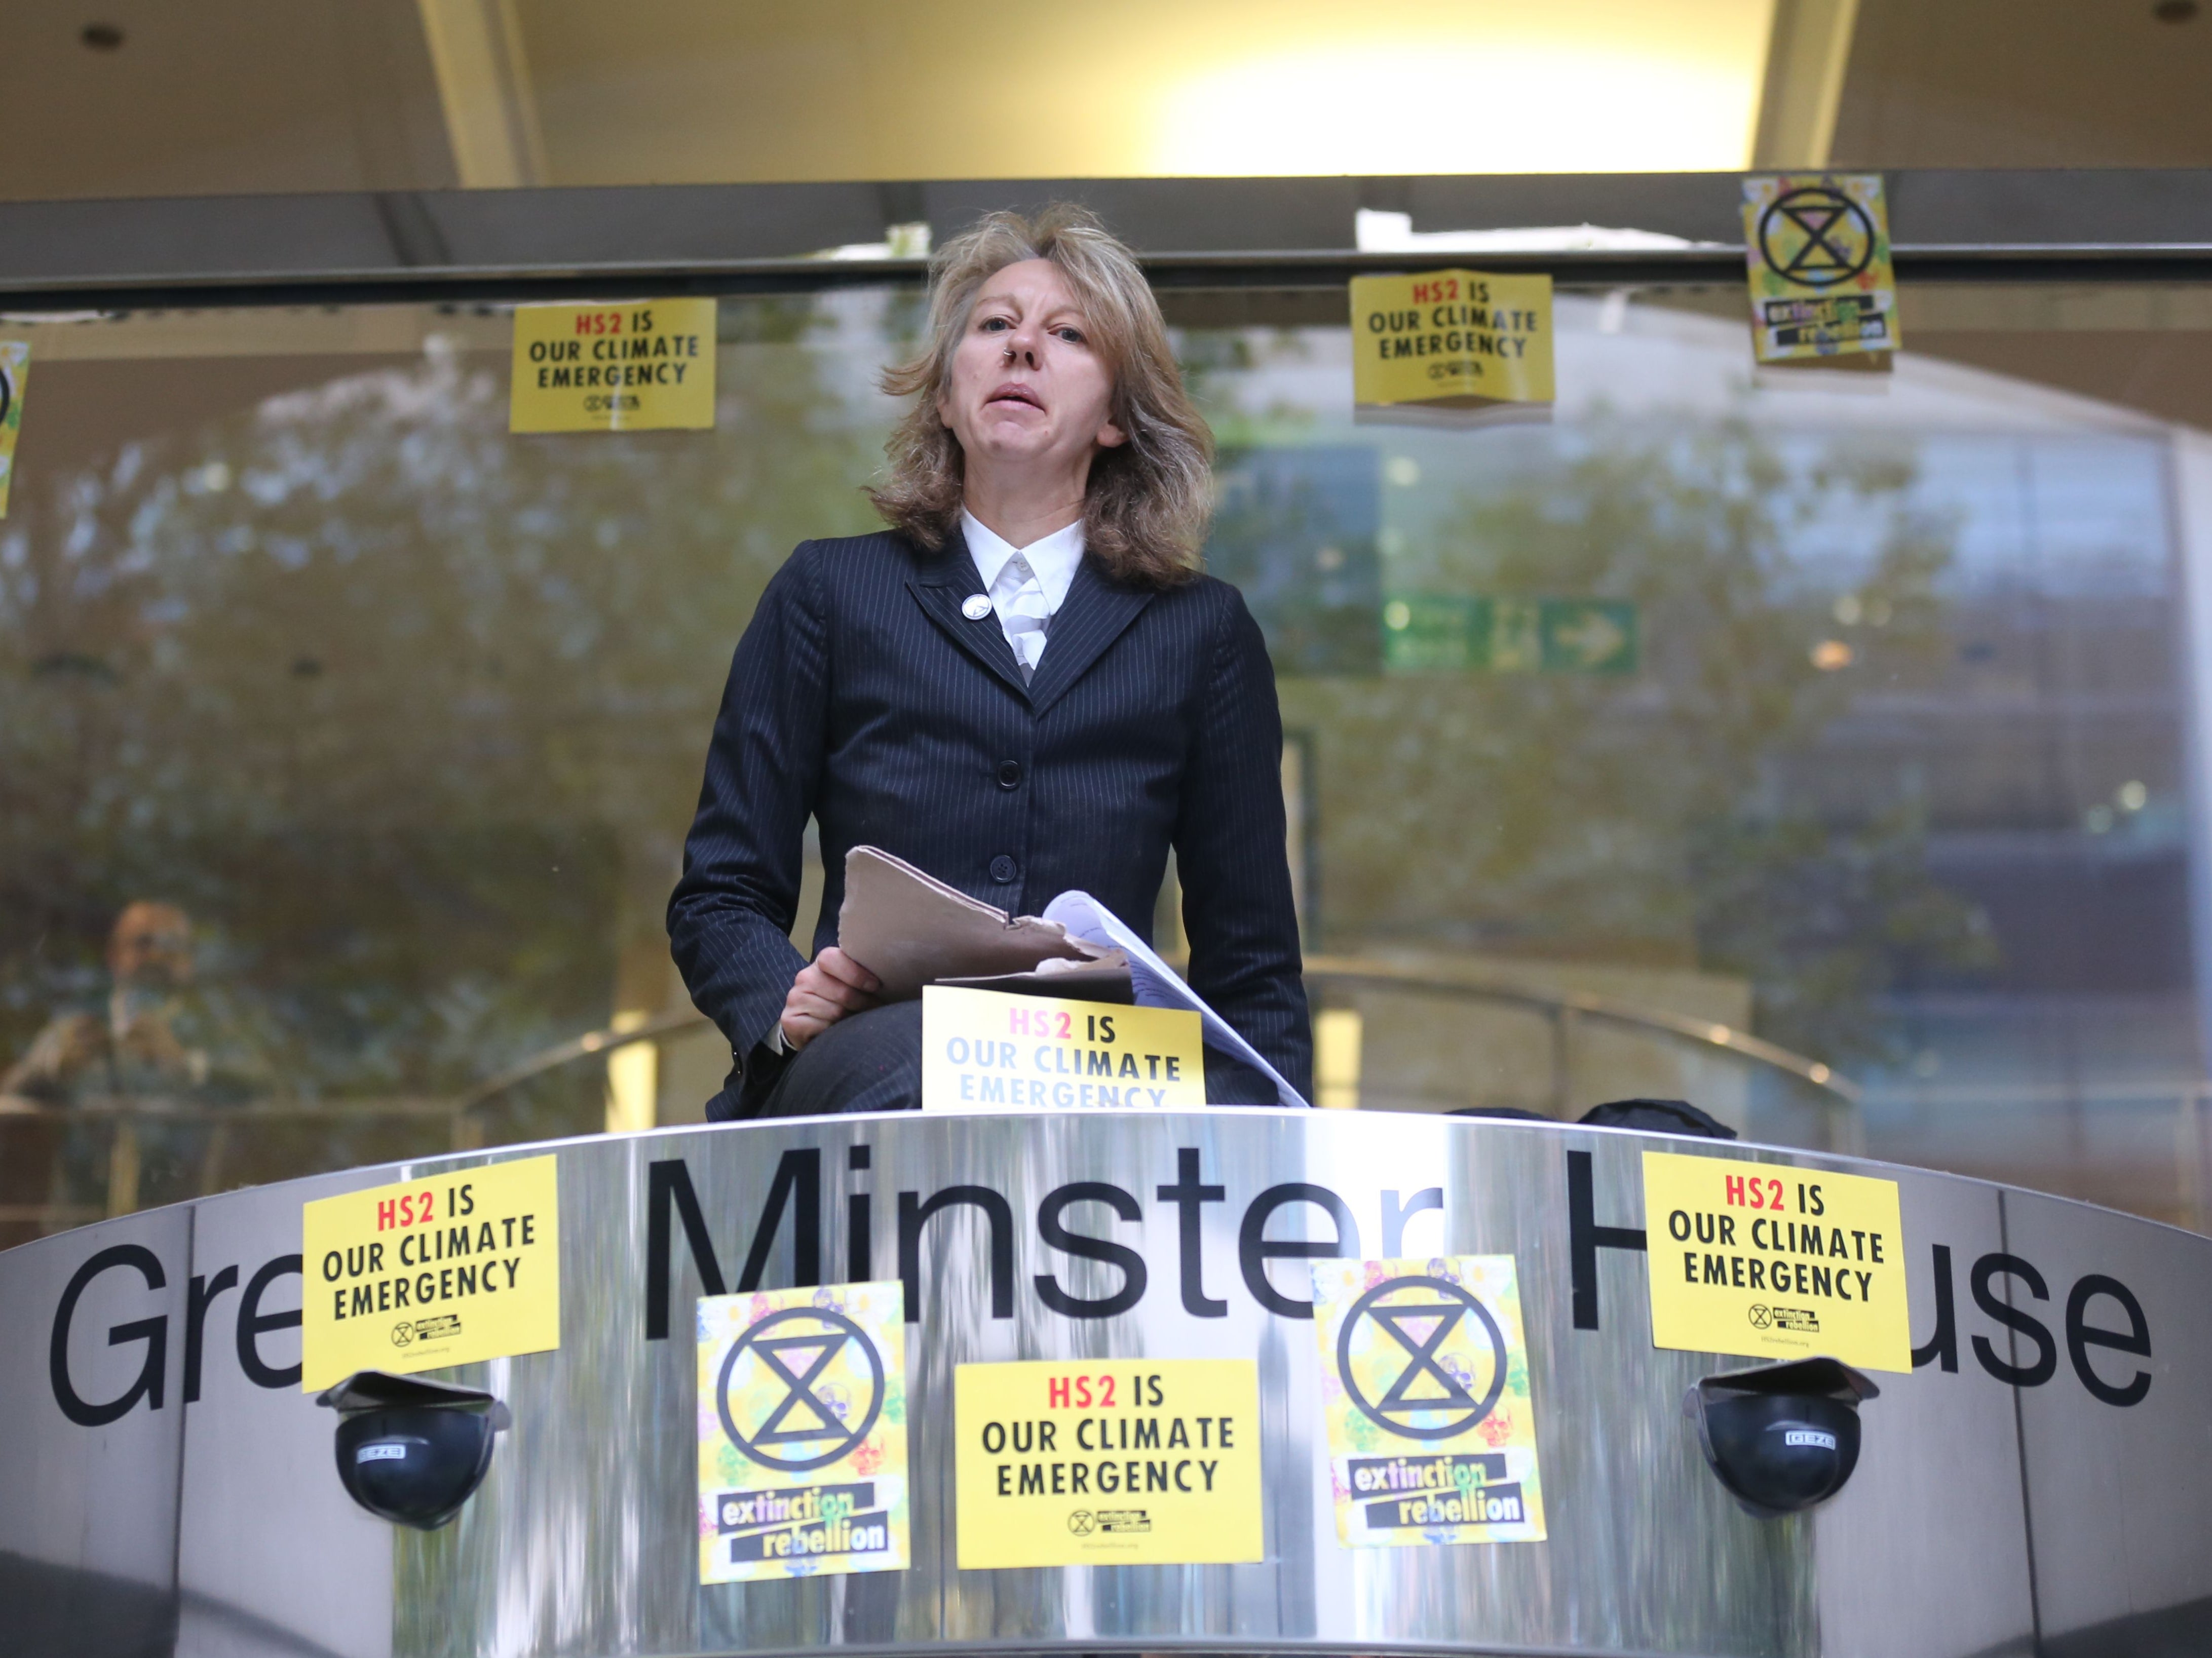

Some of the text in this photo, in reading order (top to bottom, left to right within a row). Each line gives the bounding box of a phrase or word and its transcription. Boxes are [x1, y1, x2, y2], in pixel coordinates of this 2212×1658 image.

[1413, 279, 1490, 304] HS2 IS
[576, 310, 653, 335] HS2 IS
[1369, 306, 1537, 333] OUR CLIMATE
[529, 335, 699, 362] OUR CLIMATE
[1379, 331, 1527, 359] EMERGENCY
[538, 363, 687, 388] EMERGENCY
[1010, 1008, 1116, 1044] HS2 IS
[946, 1036, 1180, 1082] OUR CLIMATE
[960, 1073, 1166, 1108] EMERGENCY
[377, 1184, 474, 1231] HS2 IS
[1726, 1175, 1825, 1216] HS2 IS
[323, 1214, 535, 1282] OUR CLIMATE
[646, 1145, 1443, 1339] Minster
[1669, 1210, 1884, 1264] OUR CLIMATE
[334, 1257, 521, 1321] EMERGENCY
[1684, 1252, 1873, 1302] EMERGENCY
[1774, 1308, 1810, 1321] extinction
[1786, 1319, 1819, 1332] rebellion
[1049, 1375, 1164, 1409] HS2 IS
[982, 1417, 1234, 1453] OUR CLIMATE
[1788, 1433, 1834, 1448] GEZE
[998, 1459, 1218, 1496] EMERGENCY
[1354, 1456, 1488, 1491] extinction
[722, 1487, 855, 1526] extinction
[1398, 1487, 1521, 1525] rebellion
[762, 1516, 886, 1558] rebellion
